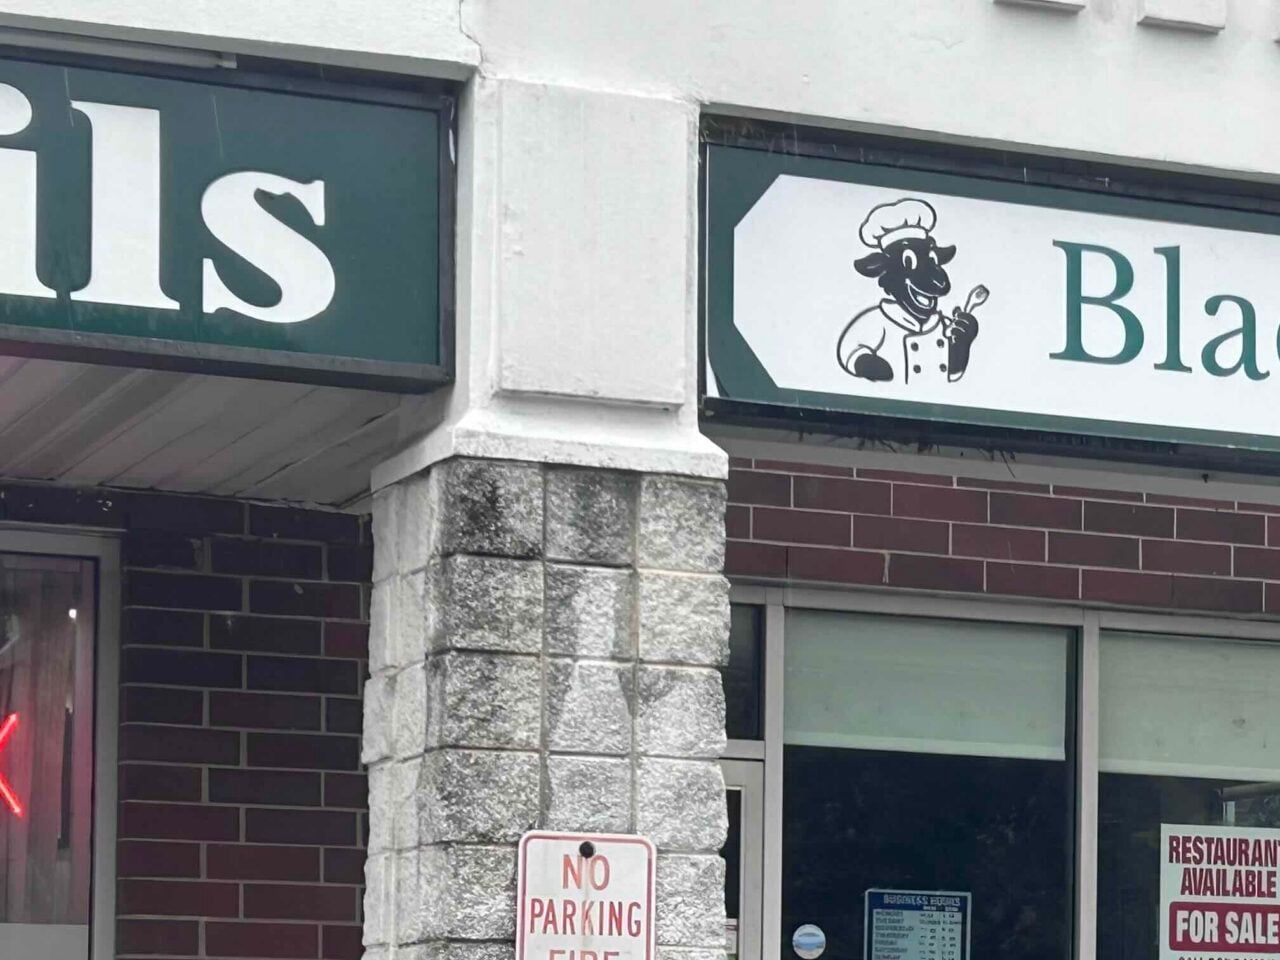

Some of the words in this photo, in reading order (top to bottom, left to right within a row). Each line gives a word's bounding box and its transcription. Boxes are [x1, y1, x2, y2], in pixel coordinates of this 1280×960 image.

[563, 854, 610, 890] NO
[1181, 867, 1277, 898] AVAILABLE
[530, 898, 642, 937] PARKING
[1176, 910, 1219, 943] FOR
[1225, 911, 1280, 944] SALE
